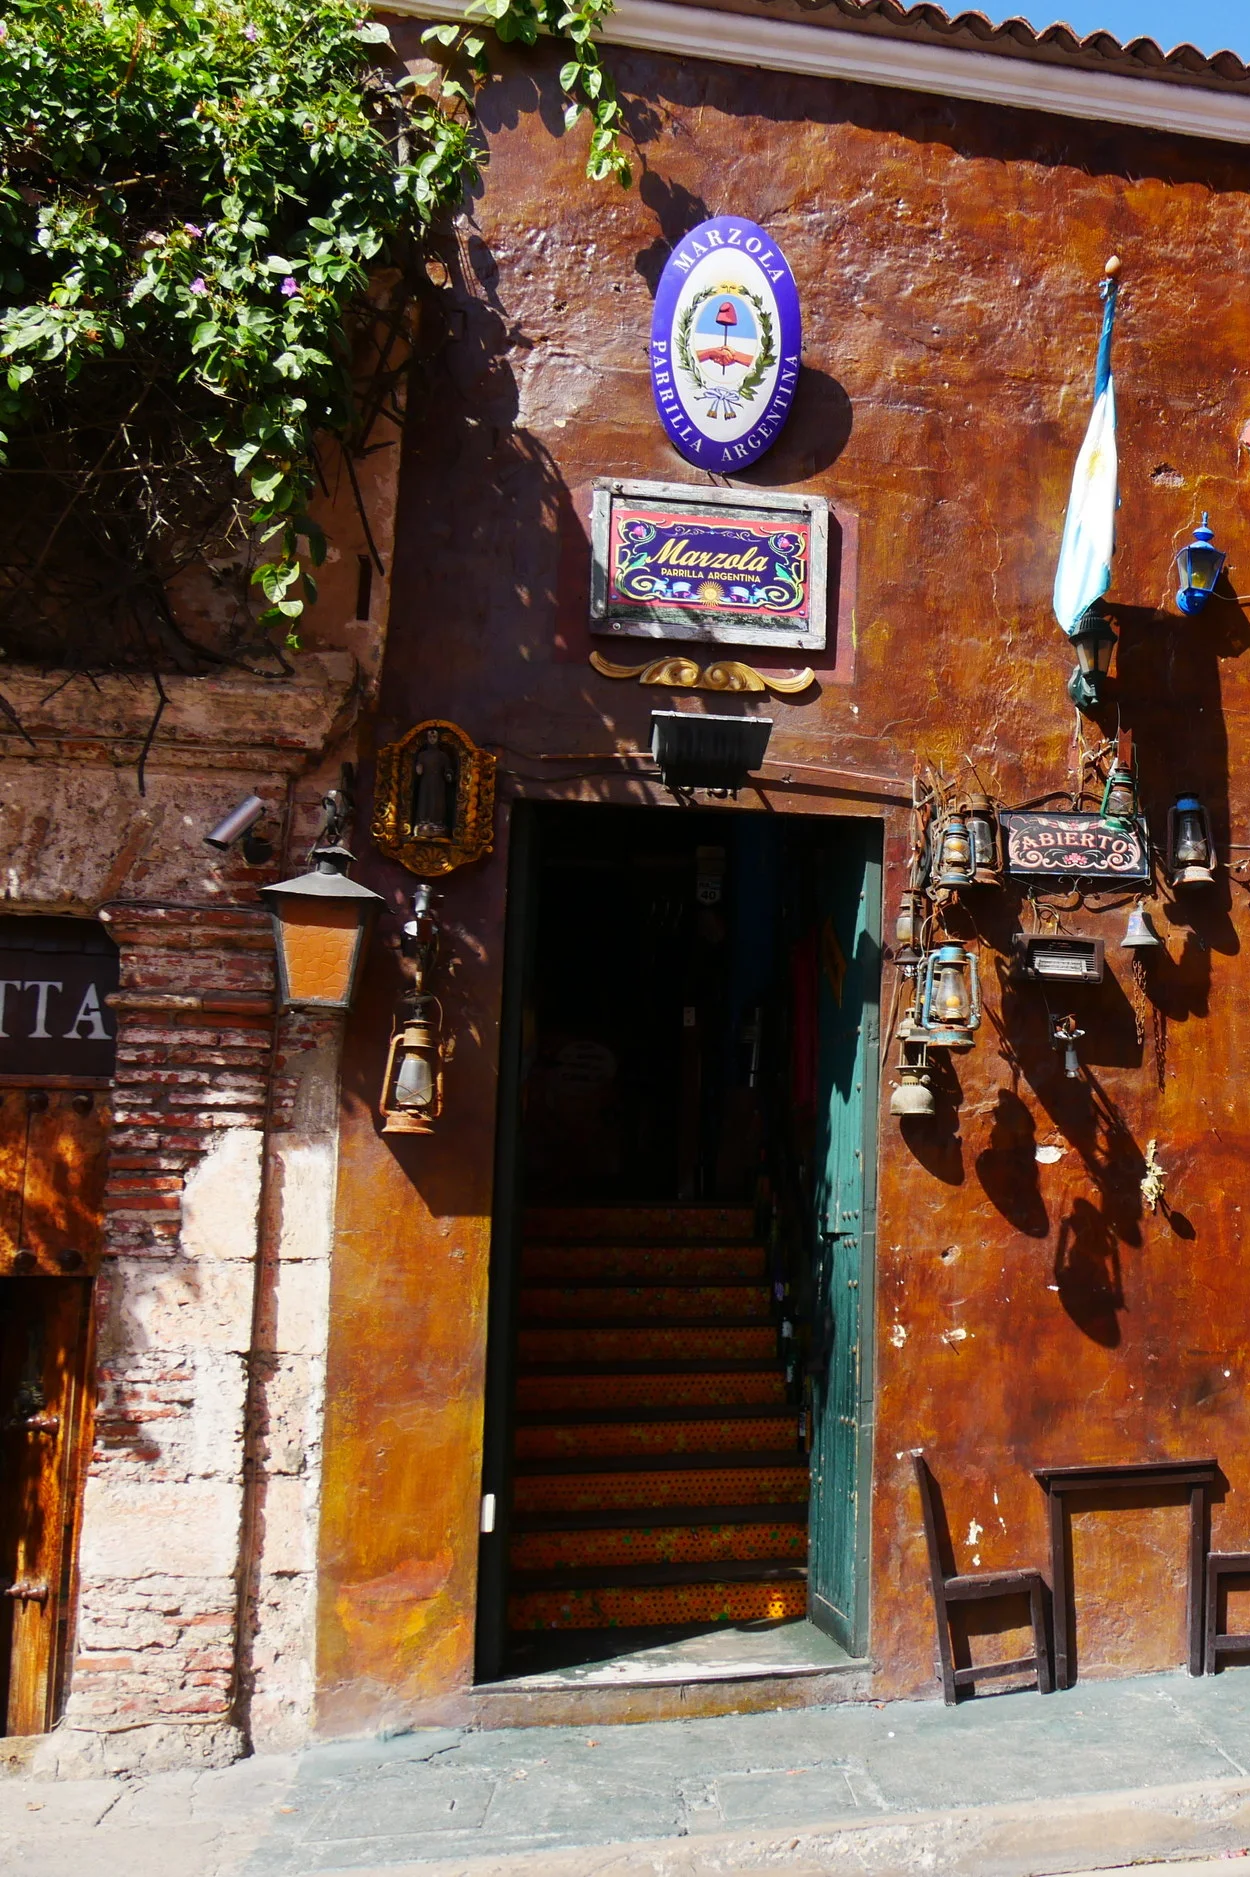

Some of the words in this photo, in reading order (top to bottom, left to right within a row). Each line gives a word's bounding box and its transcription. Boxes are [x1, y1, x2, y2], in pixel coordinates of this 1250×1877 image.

[673, 228, 786, 285] MARZOLA
[652, 340, 703, 454] PARRILLA
[720, 355, 799, 462] ARGENTINA
[647, 539, 768, 571] Marzola
[660, 567, 705, 579] PARRILLA
[707, 571, 762, 583] ARGENTINA
[1022, 832, 1128, 853] ABIERTO
